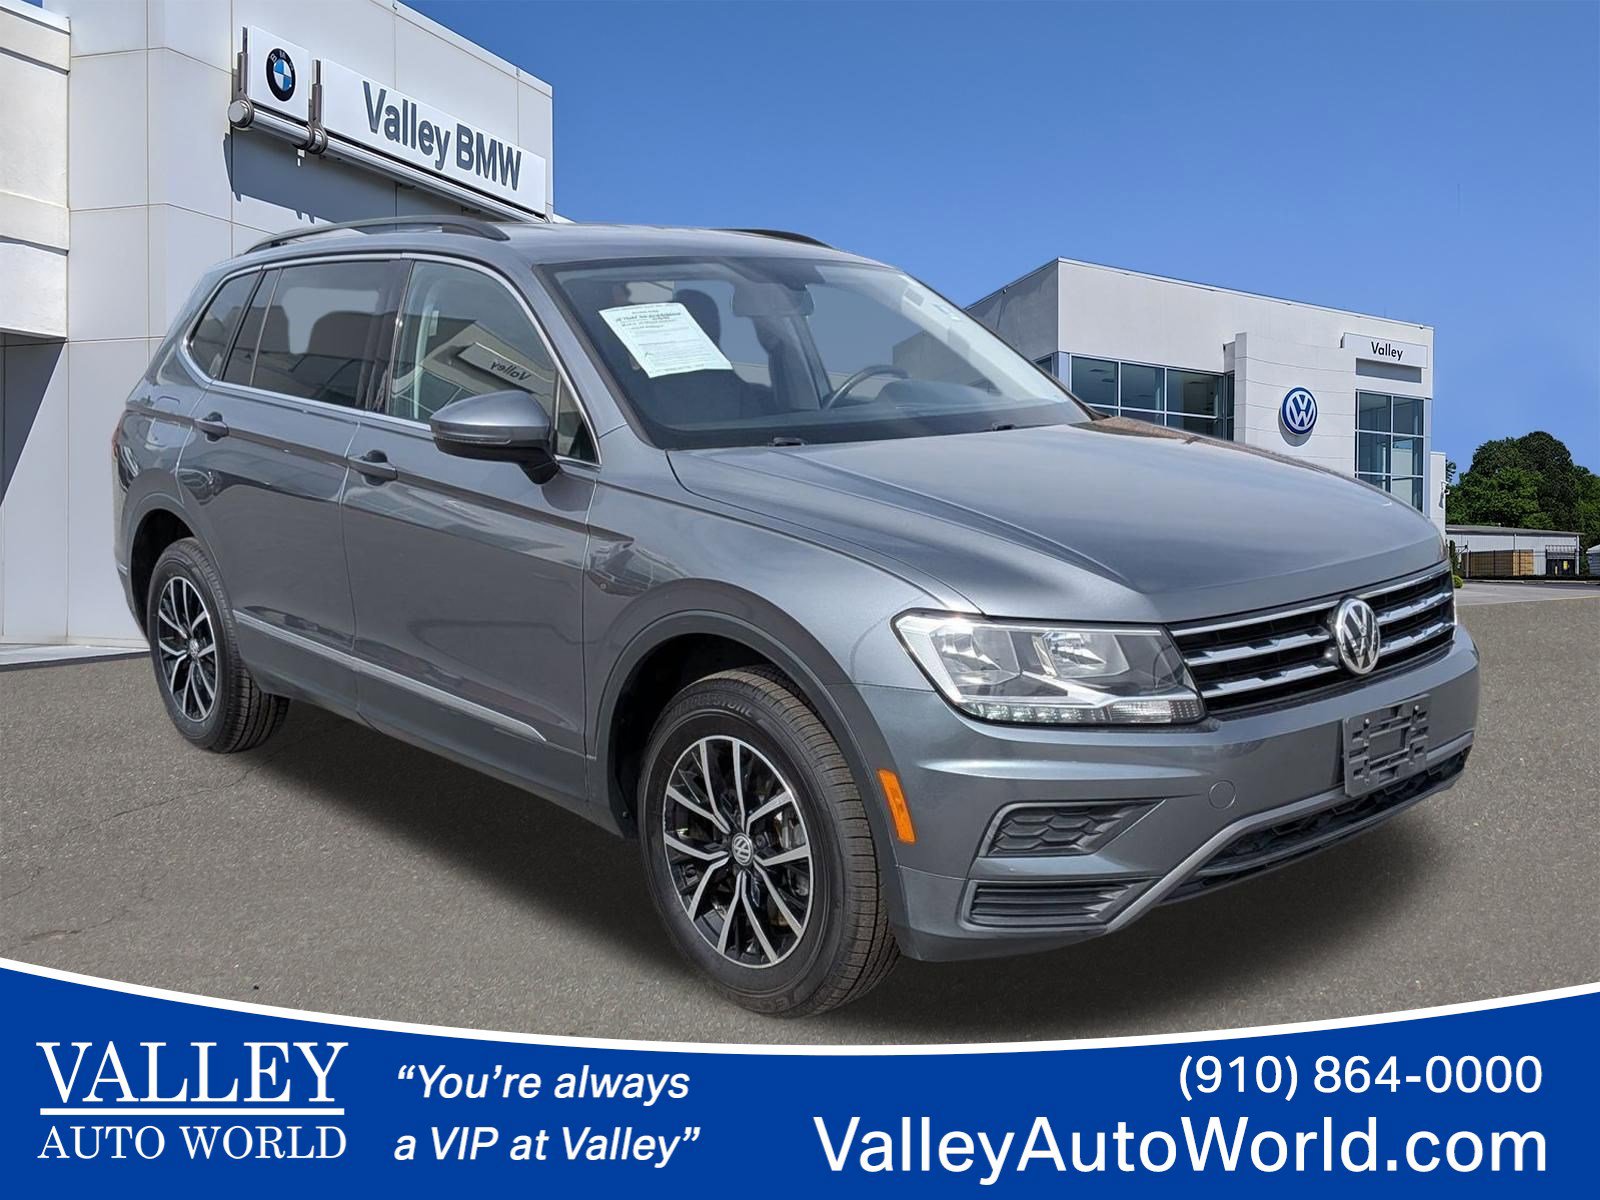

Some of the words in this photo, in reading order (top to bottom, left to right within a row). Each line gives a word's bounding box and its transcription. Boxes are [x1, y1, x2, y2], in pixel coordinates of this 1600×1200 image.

[361, 80, 451, 171] Valley
[455, 123, 522, 191] BMW
[1371, 341, 1404, 361] Valley
